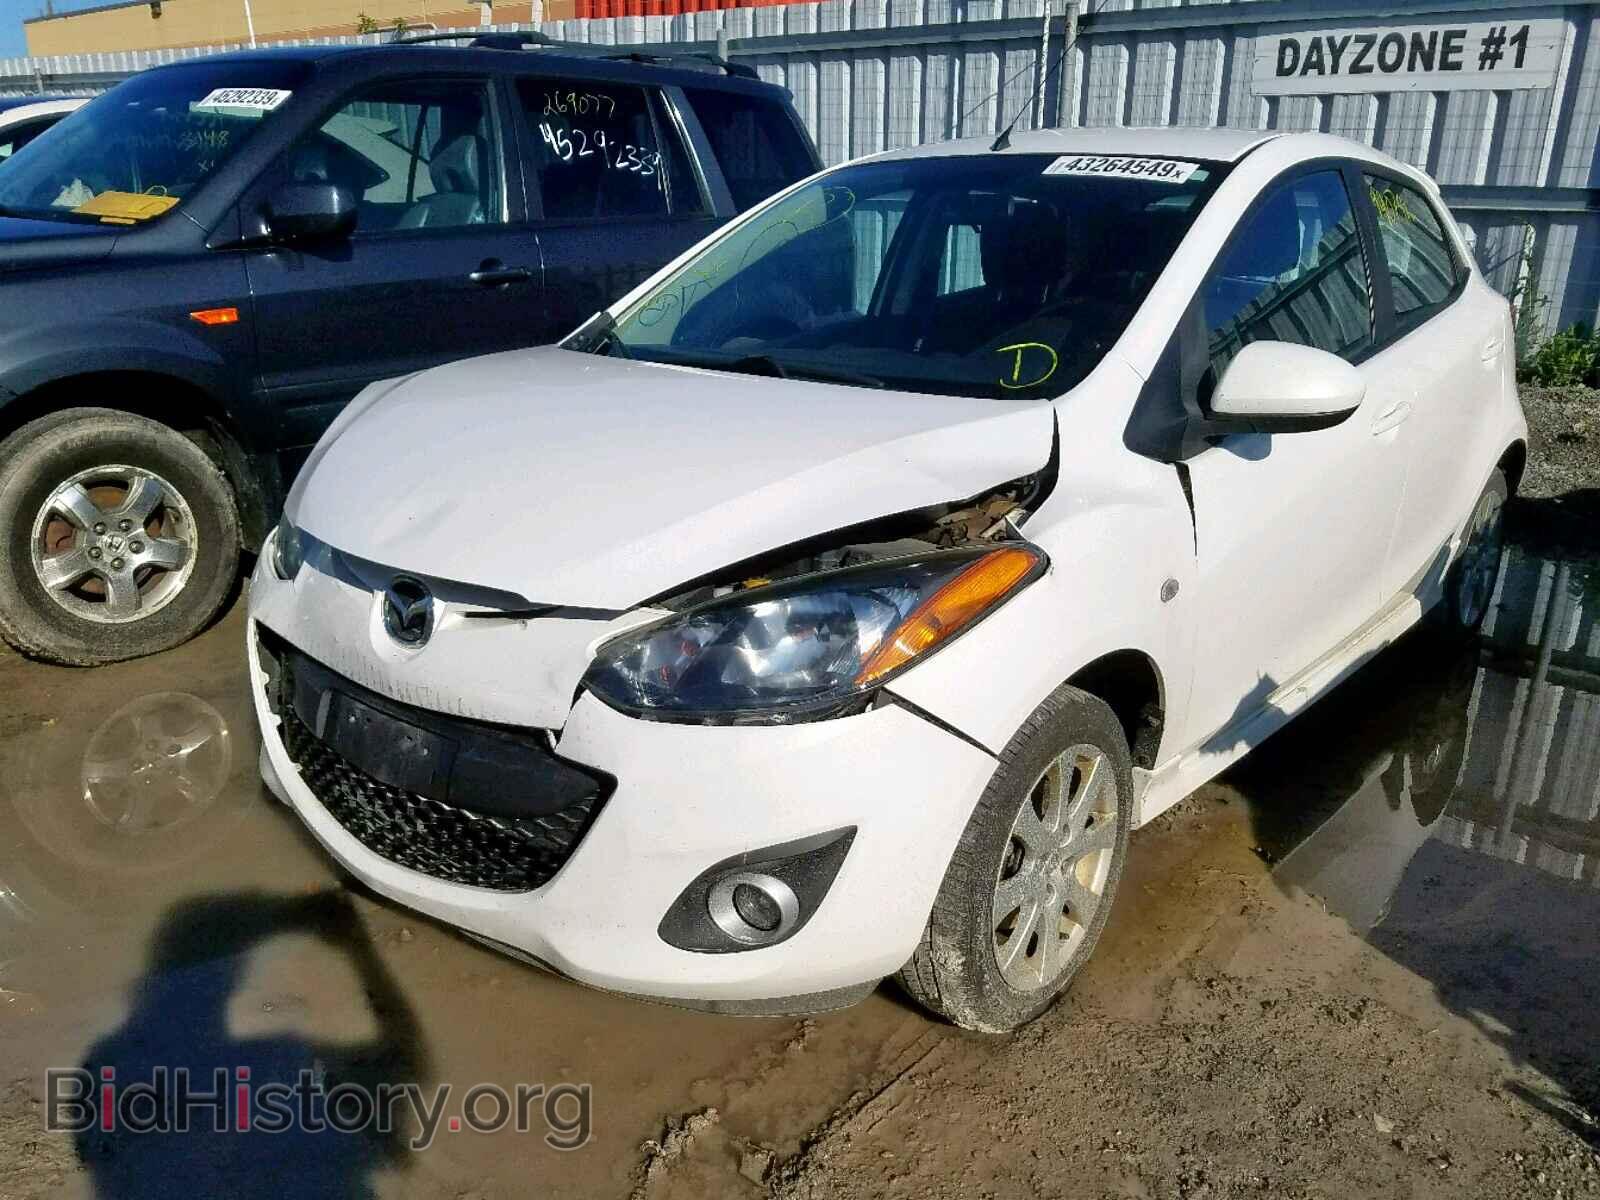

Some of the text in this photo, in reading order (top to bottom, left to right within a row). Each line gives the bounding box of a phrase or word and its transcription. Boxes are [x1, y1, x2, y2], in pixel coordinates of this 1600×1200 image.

[1276, 24, 1530, 77] DAYZONE #1
[996, 342, 1058, 389] D
